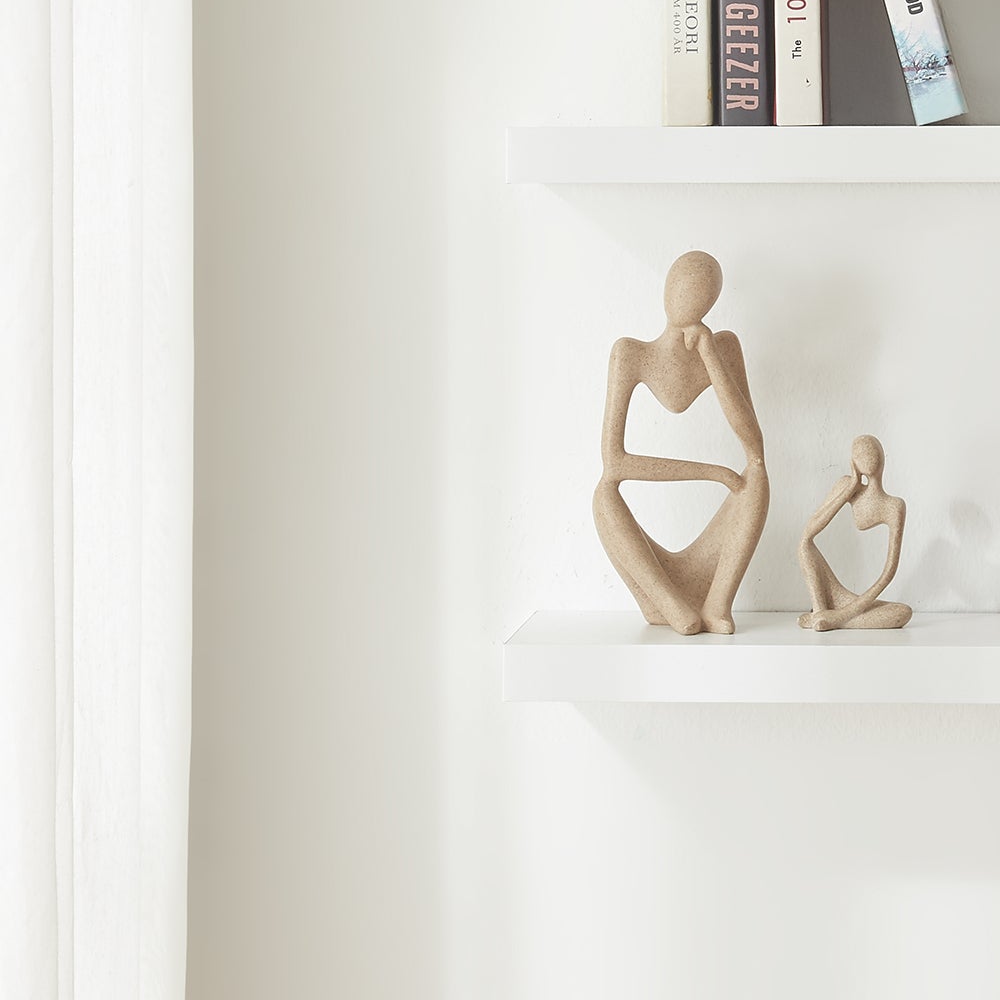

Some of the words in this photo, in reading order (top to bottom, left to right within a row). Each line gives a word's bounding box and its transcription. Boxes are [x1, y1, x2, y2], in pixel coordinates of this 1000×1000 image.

[673, 12, 681, 34] 400
[725, 2, 760, 111] GEEZER
[789, 39, 802, 60] The
